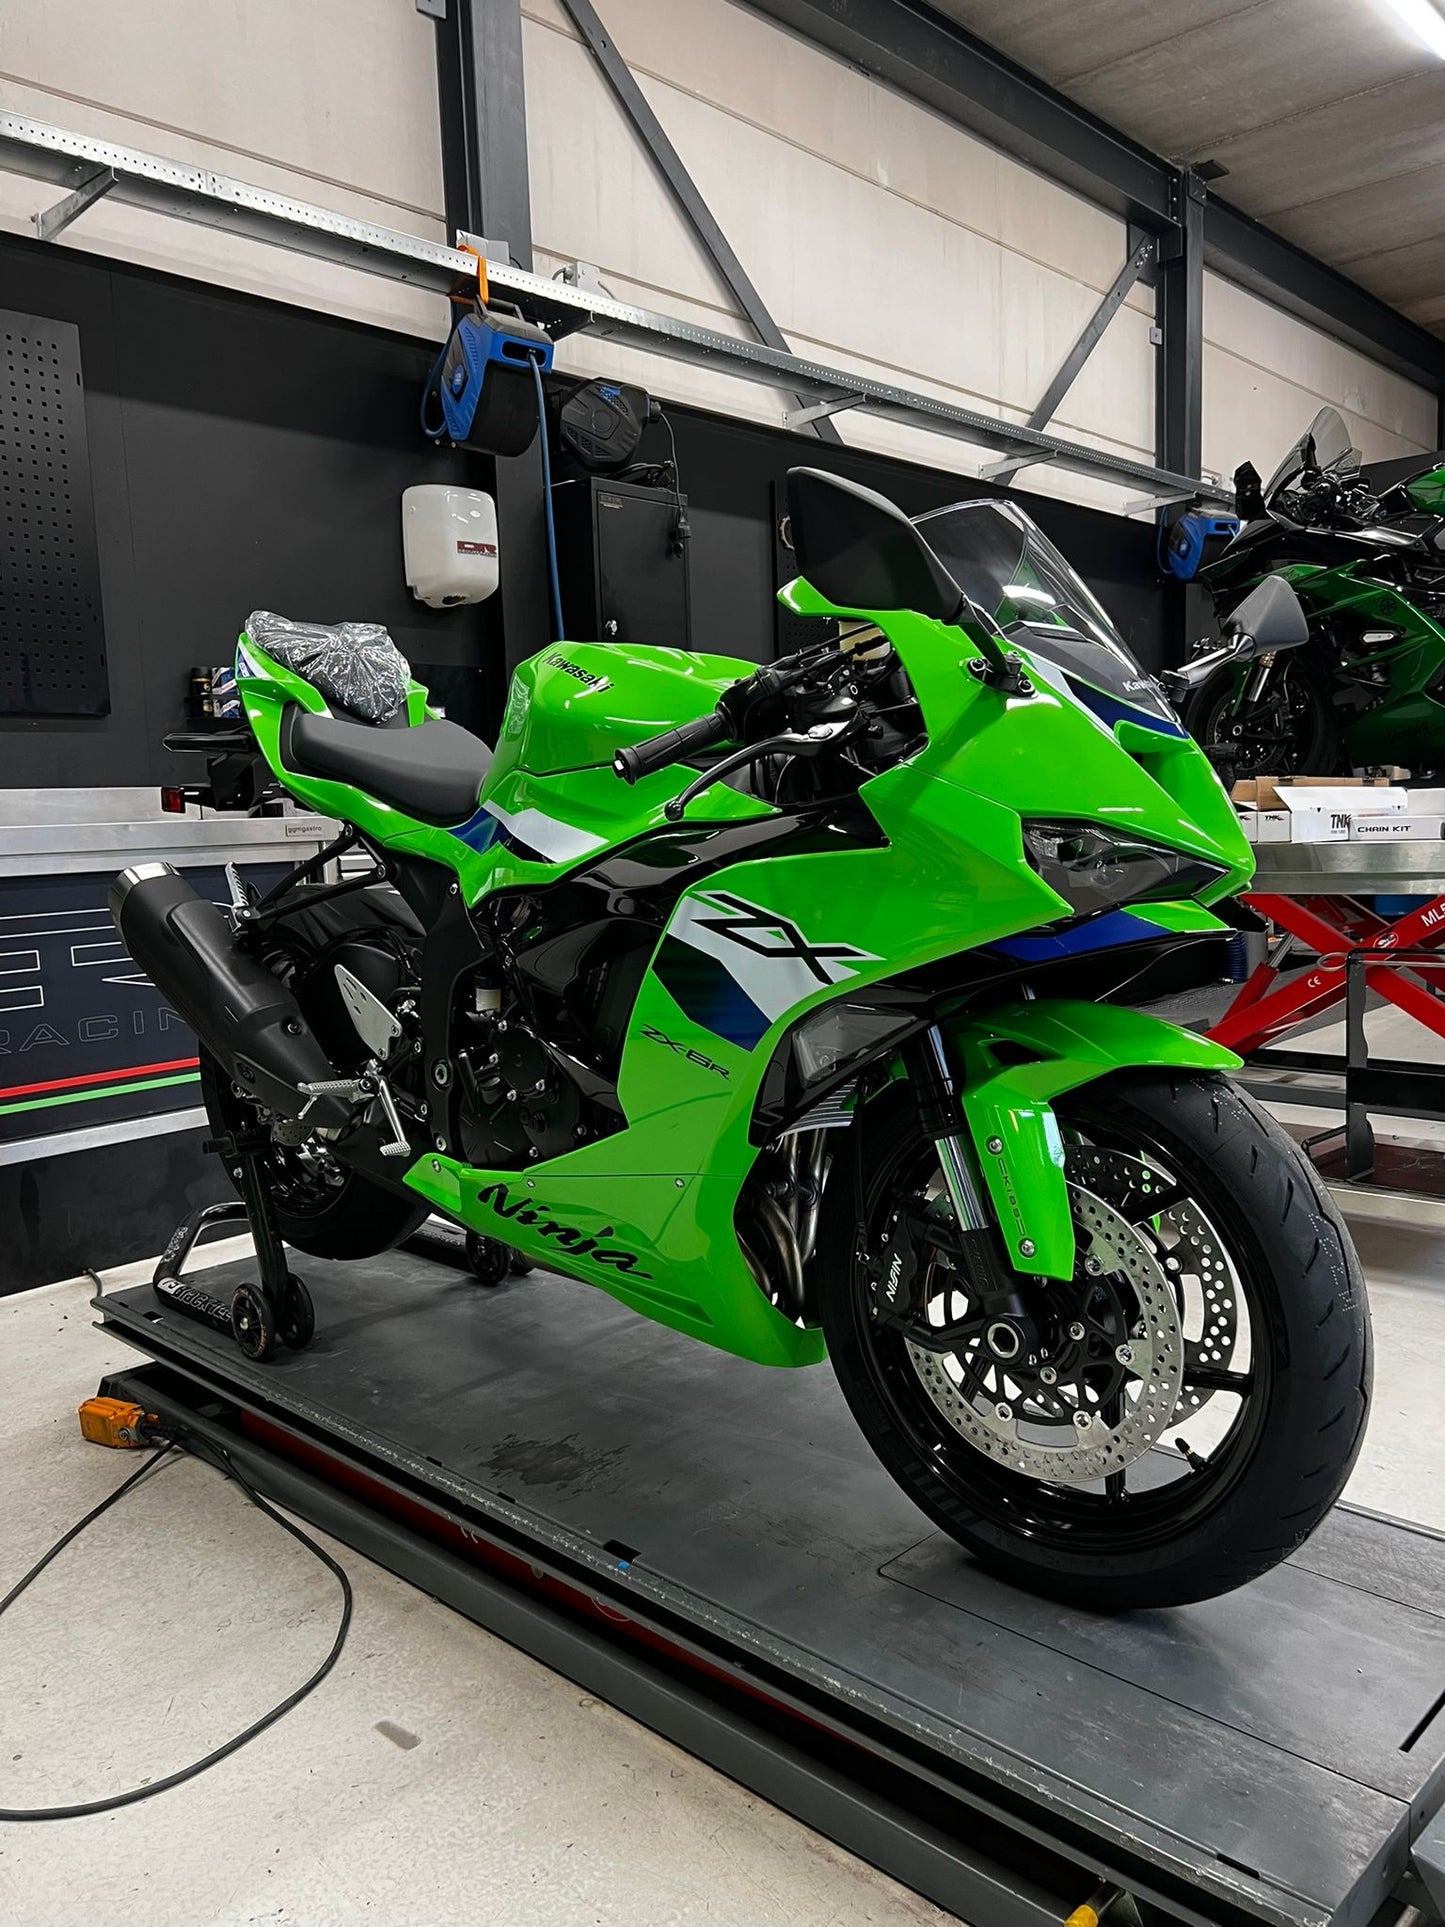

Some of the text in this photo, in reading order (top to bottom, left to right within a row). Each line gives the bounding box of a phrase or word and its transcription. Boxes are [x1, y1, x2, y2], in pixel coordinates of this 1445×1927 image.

[543, 652, 615, 693] Kawasaki
[1357, 825, 1390, 833] CHAIN
[689, 892, 868, 986] ZX
[1307, 976, 1322, 988] CE
[0, 1006, 188, 1055] ACIN
[639, 1023, 731, 1081] ZX-6R
[477, 1182, 656, 1281] Ninja
[885, 1252, 903, 1303] NISSIN
